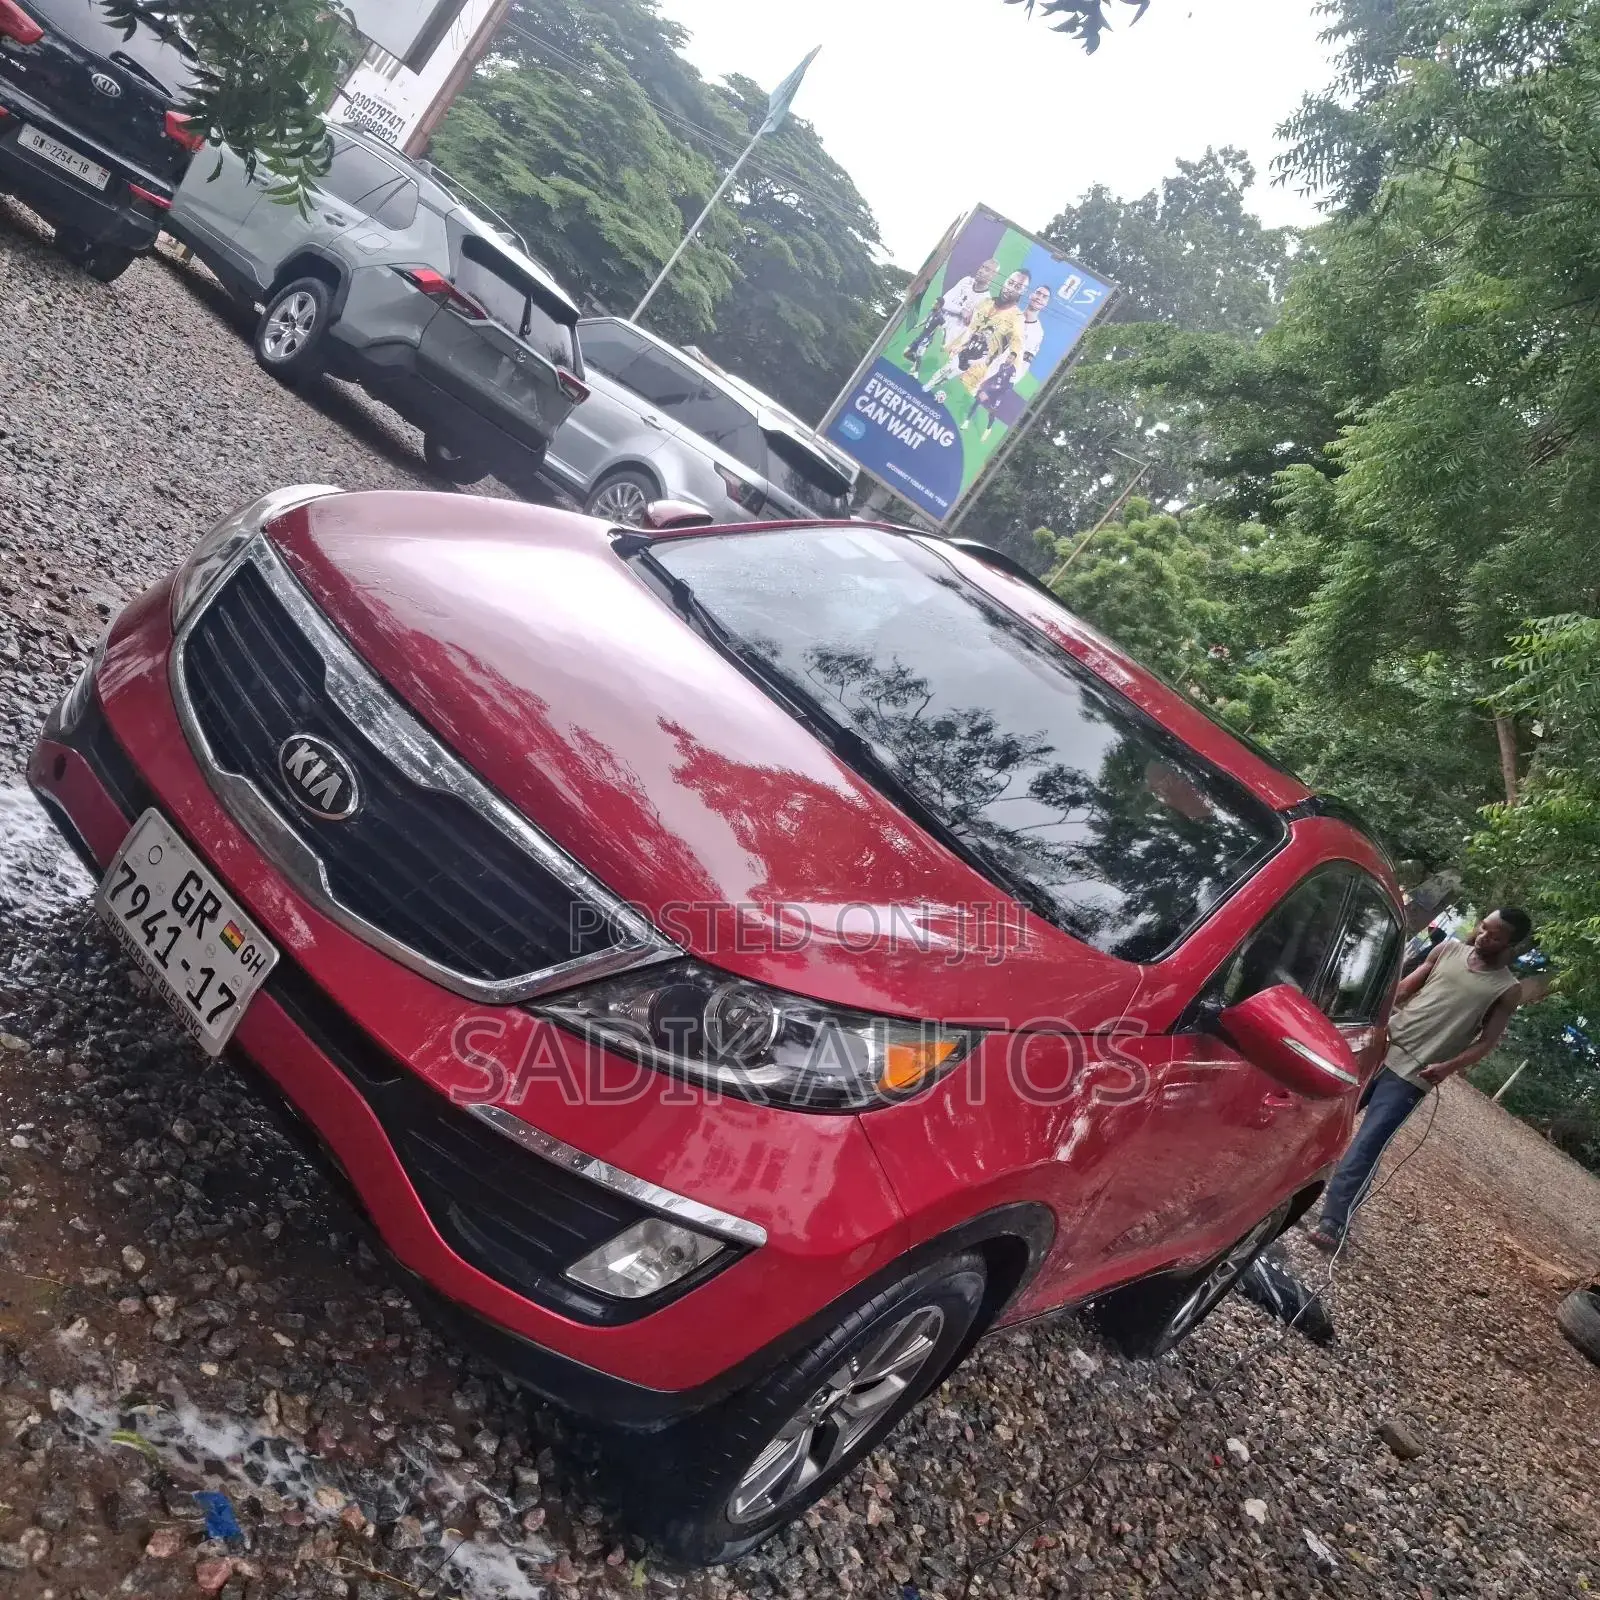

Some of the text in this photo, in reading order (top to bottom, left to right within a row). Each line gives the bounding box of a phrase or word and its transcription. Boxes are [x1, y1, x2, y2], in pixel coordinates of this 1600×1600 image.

[95, 75, 117, 96] KIA
[352, 91, 406, 133] 0302797471
[50, 145, 90, 174] 2254-18
[854, 394, 926, 450] CAN WAIT
[863, 378, 956, 448] EVERYTHING
[285, 741, 342, 810] KIA
[171, 869, 223, 940] GR
[109, 860, 238, 1025] 7941-17
[240, 944, 267, 978] GH
[105, 911, 203, 1038] SHOWERS OF BLESSING
